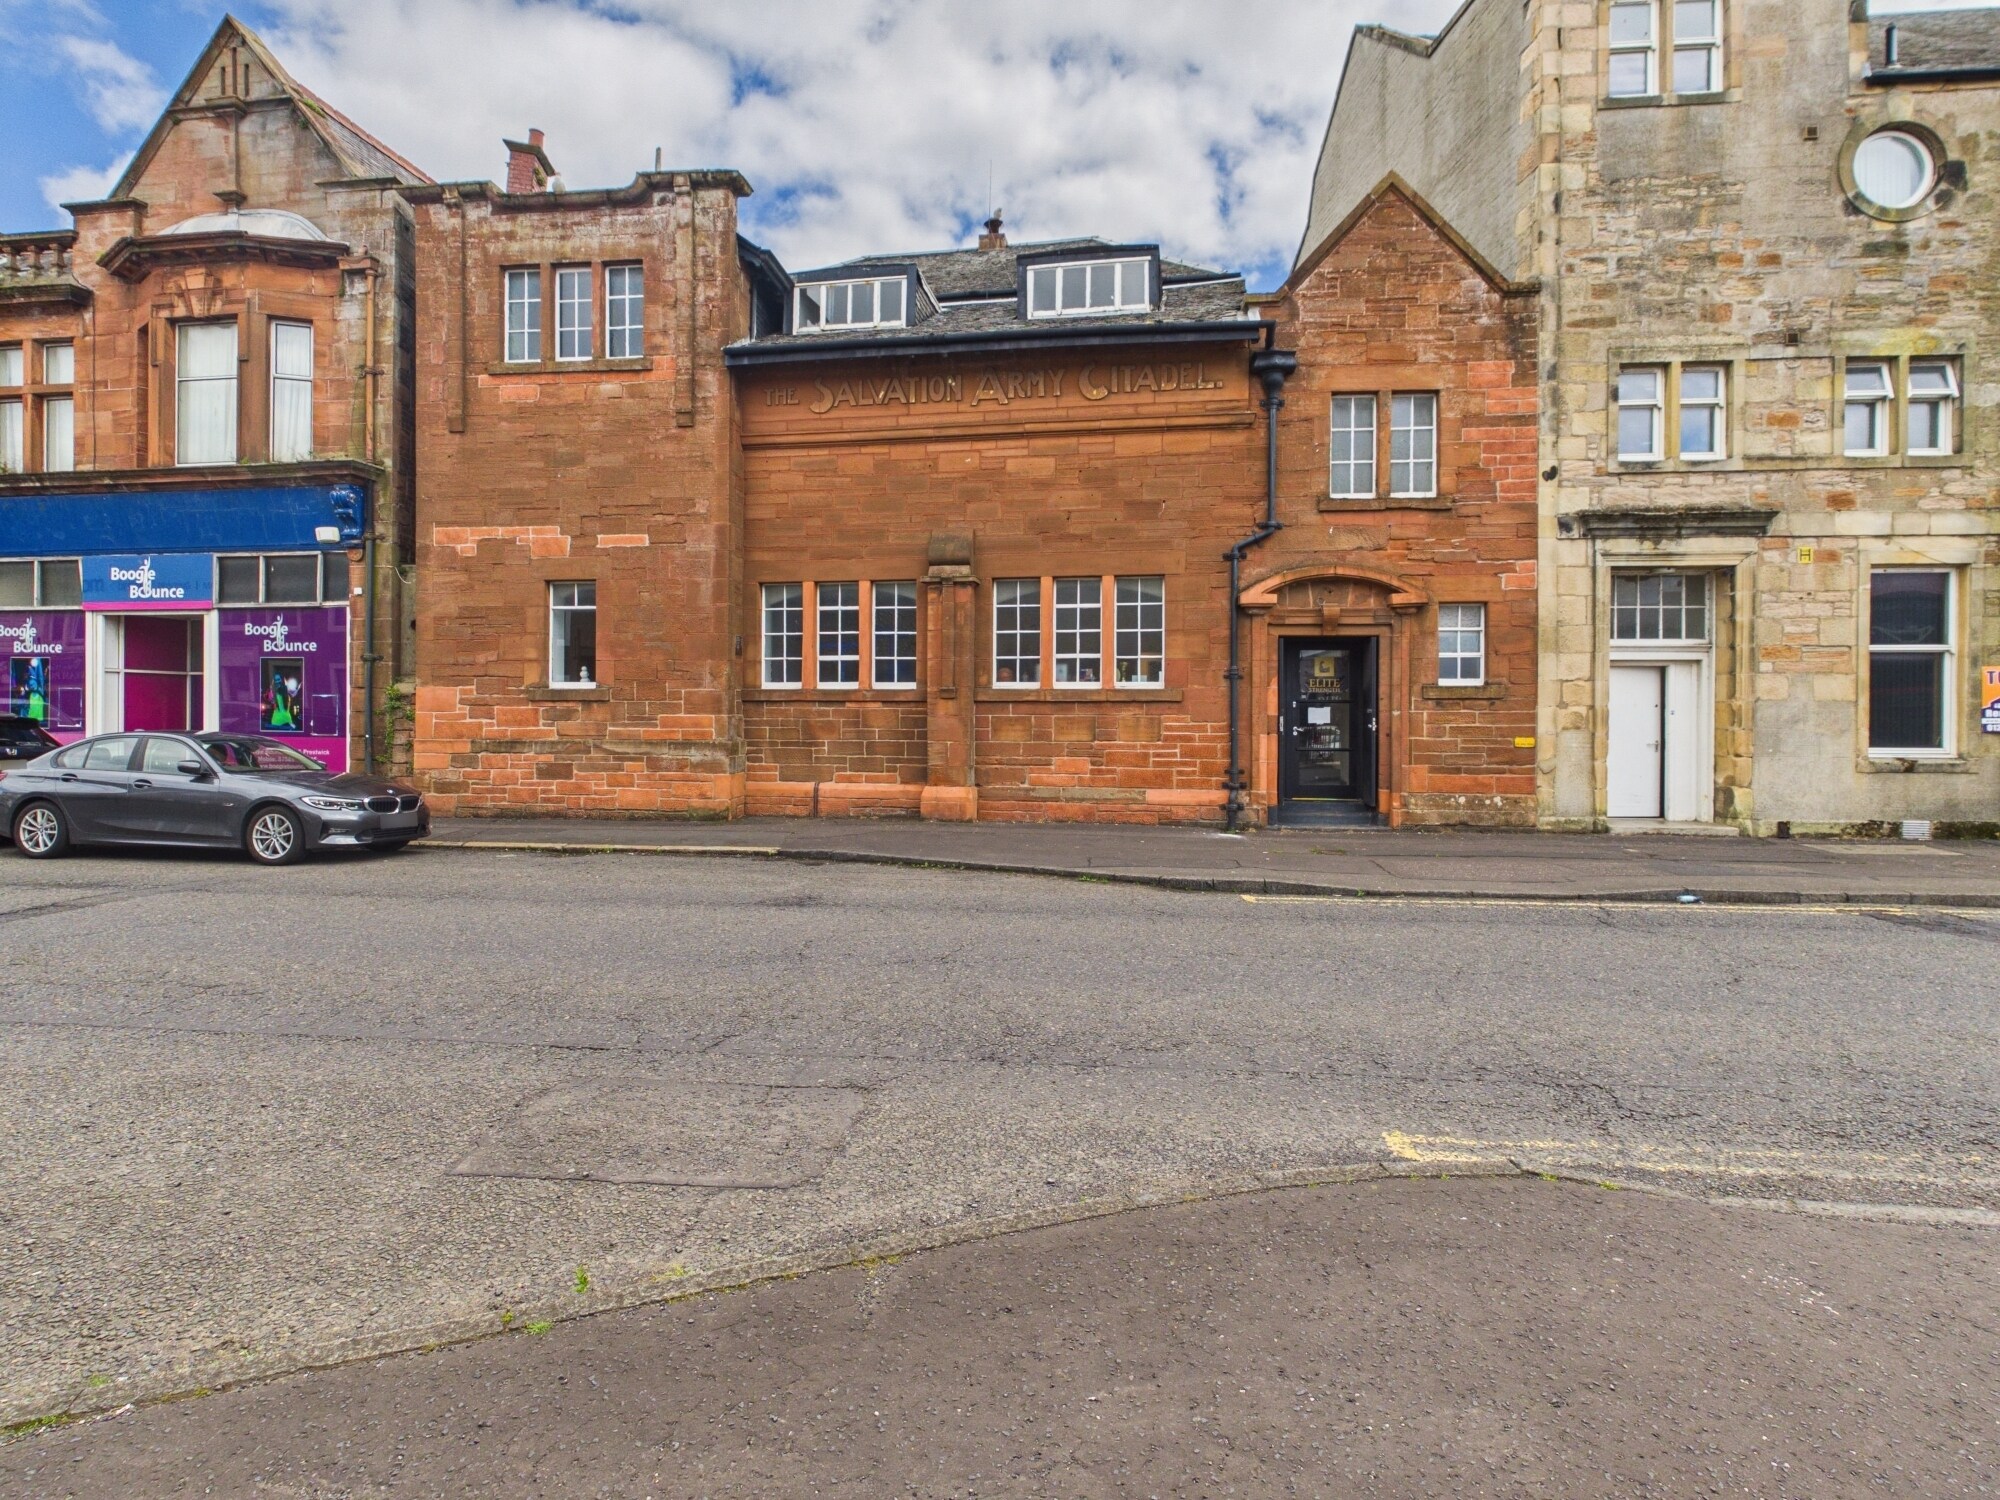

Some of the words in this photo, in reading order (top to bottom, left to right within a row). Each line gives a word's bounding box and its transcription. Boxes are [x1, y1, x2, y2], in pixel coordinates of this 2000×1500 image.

[764, 388, 799, 406] THE
[809, 376, 962, 414] SALVATION
[970, 367, 1065, 406] ARMY
[1799, 548, 1811, 561] H
[129, 585, 185, 598] Bounce
[13, 640, 63, 653] Bounce
[263, 639, 318, 652] Bounce
[1308, 678, 1341, 688] ELITE
[1986, 670, 2000, 684] T
